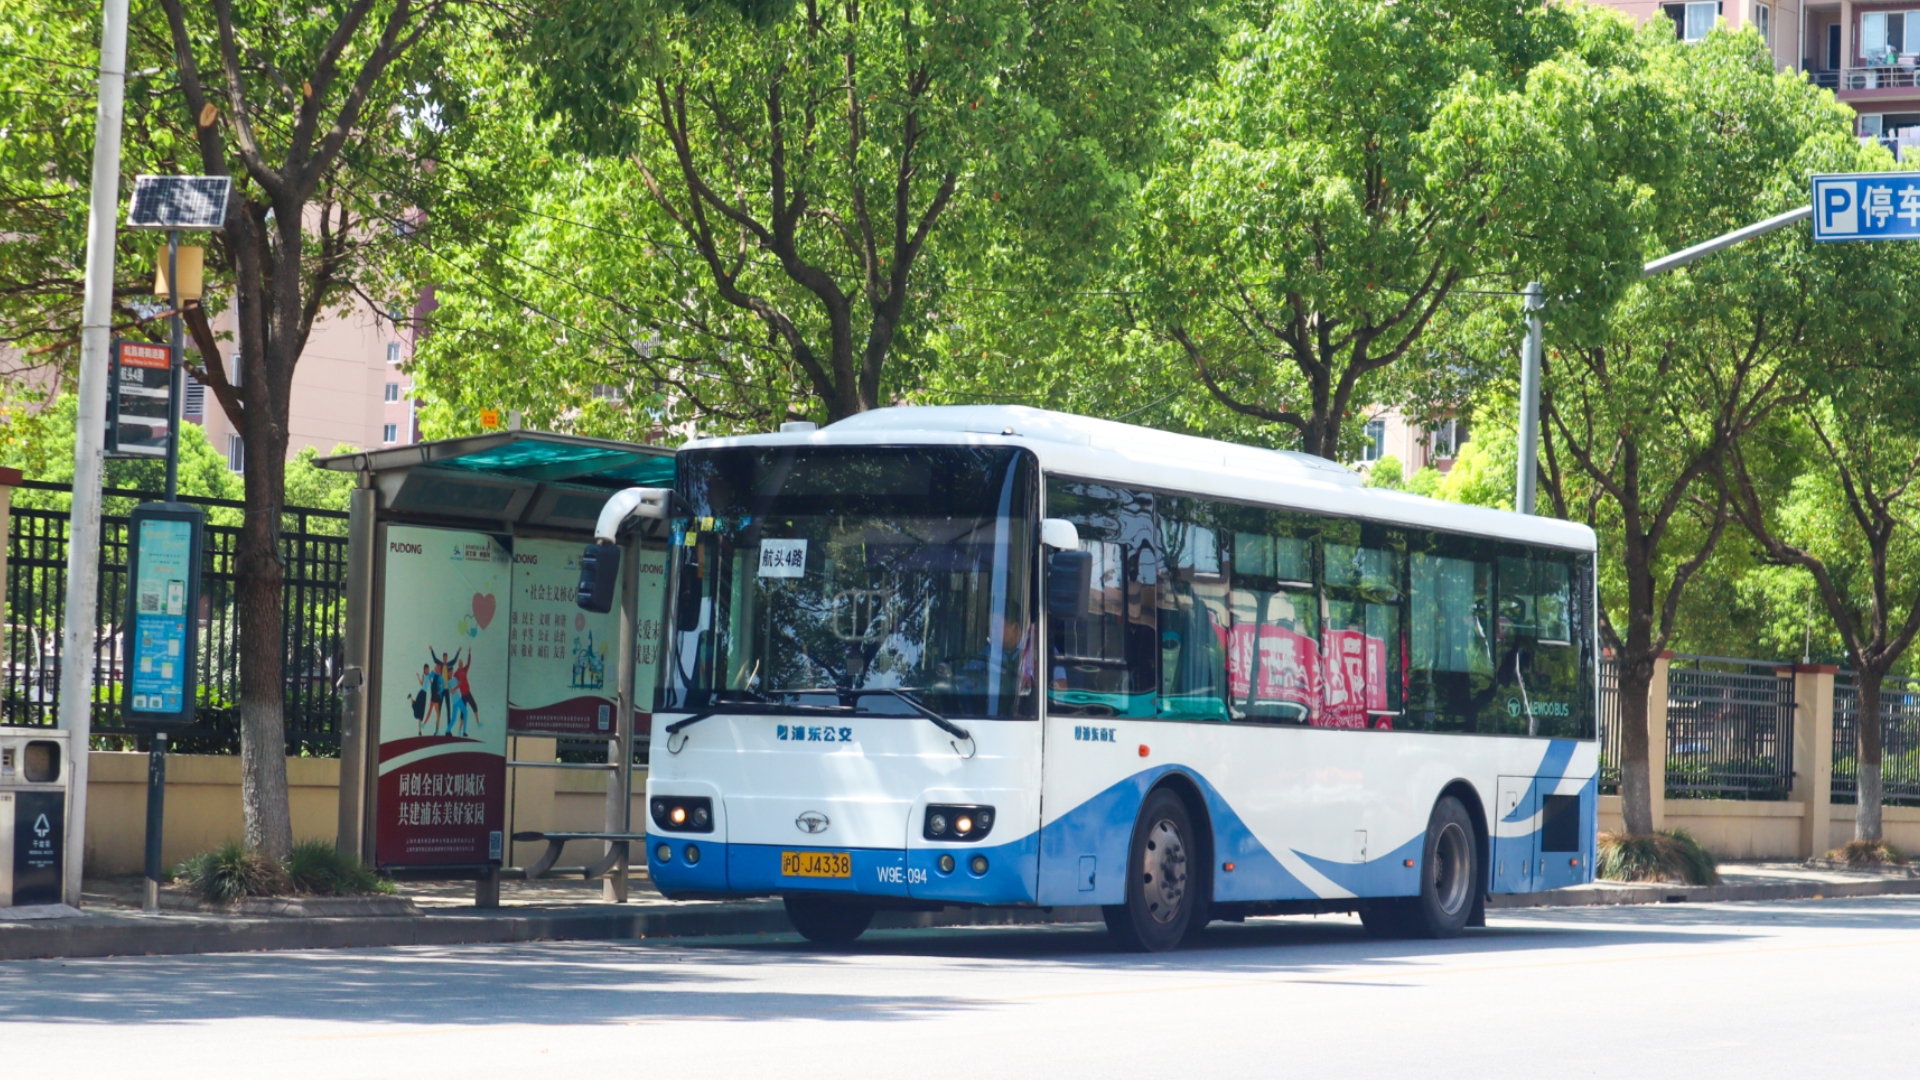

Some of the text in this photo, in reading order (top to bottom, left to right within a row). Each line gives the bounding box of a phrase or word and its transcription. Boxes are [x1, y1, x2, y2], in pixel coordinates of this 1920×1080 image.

[1825, 185, 1920, 228] P 停车
[390, 542, 422, 554] PUDONG
[762, 548, 803, 568] 航头4路
[522, 612, 534, 625] 民主
[539, 613, 551, 627] 文明
[522, 628, 534, 641] 平等
[538, 629, 550, 642] 公正
[553, 630, 566, 643] 法治
[553, 646, 565, 659] 友善
[791, 725, 852, 742] 浦东公交
[399, 773, 486, 797] 同创全国文明城区
[398, 801, 485, 826] 共建浦东美好家园
[877, 866, 928, 884] W9E-094
